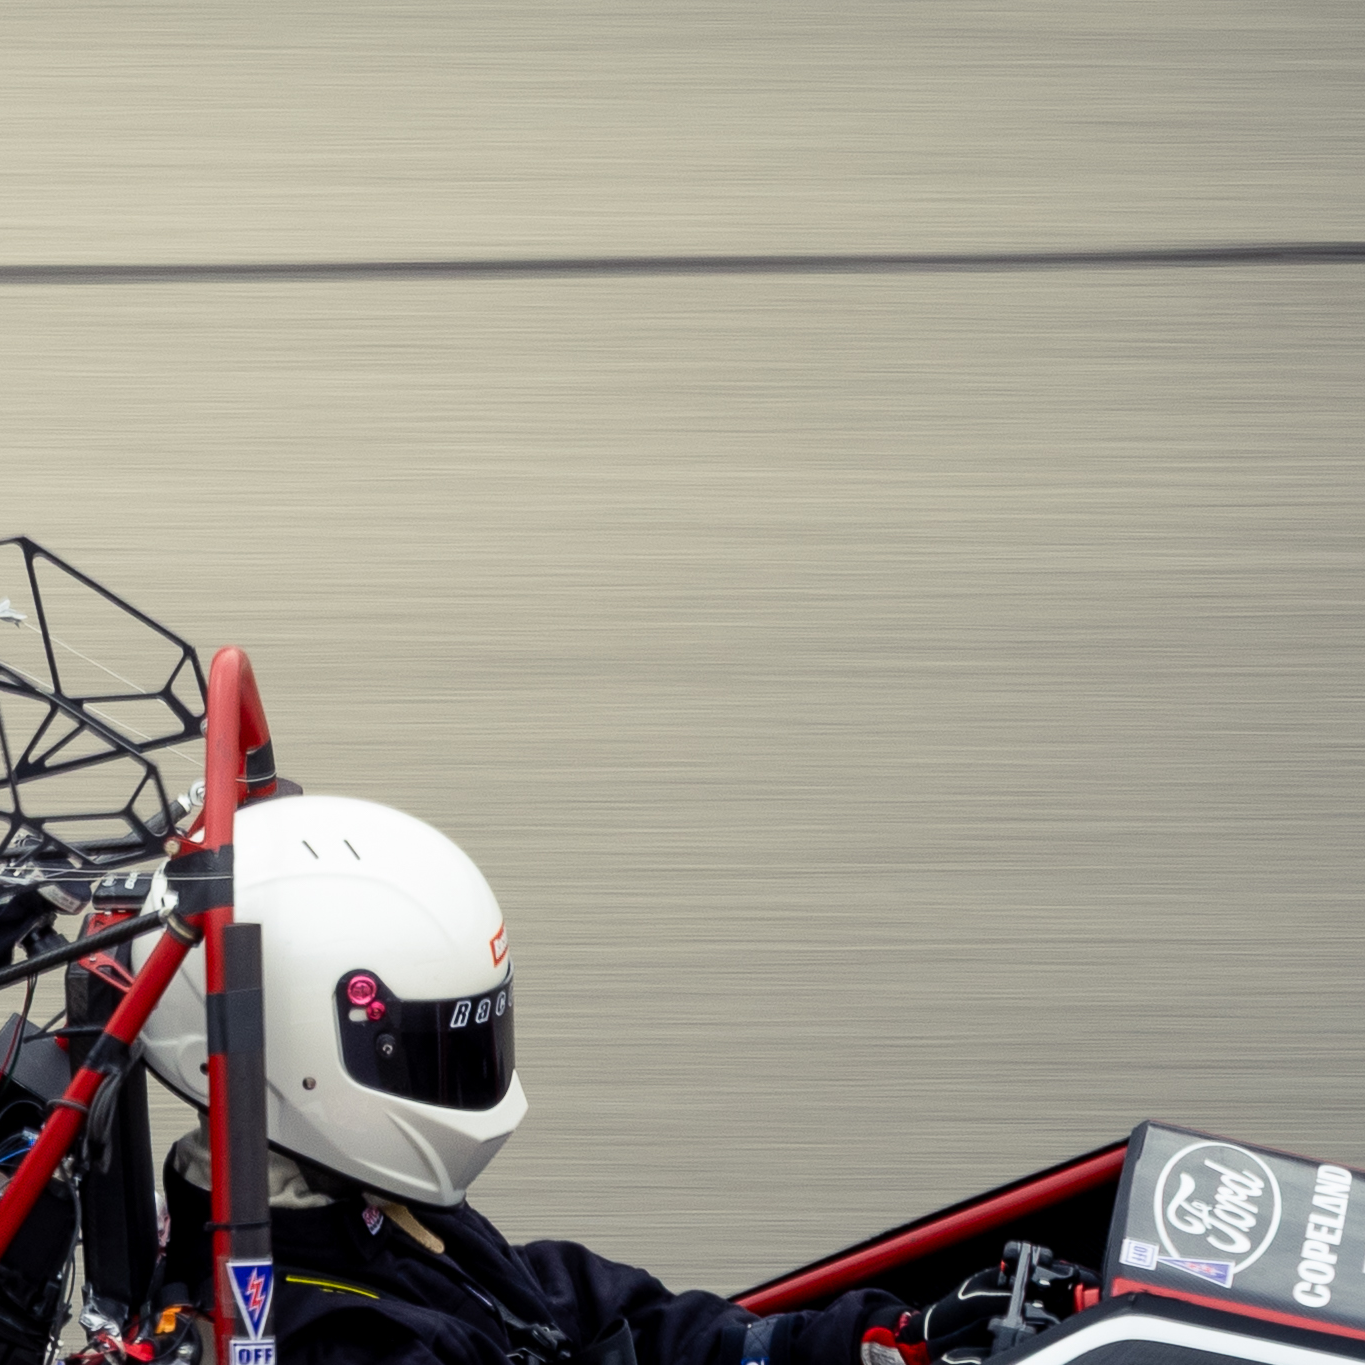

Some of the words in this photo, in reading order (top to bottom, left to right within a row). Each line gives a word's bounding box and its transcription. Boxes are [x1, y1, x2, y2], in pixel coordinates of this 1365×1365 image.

[1167, 1157, 1266, 1254] Ford
[1292, 1163, 1353, 1308] COPELAND
[238, 1348, 273, 1365] OFF
